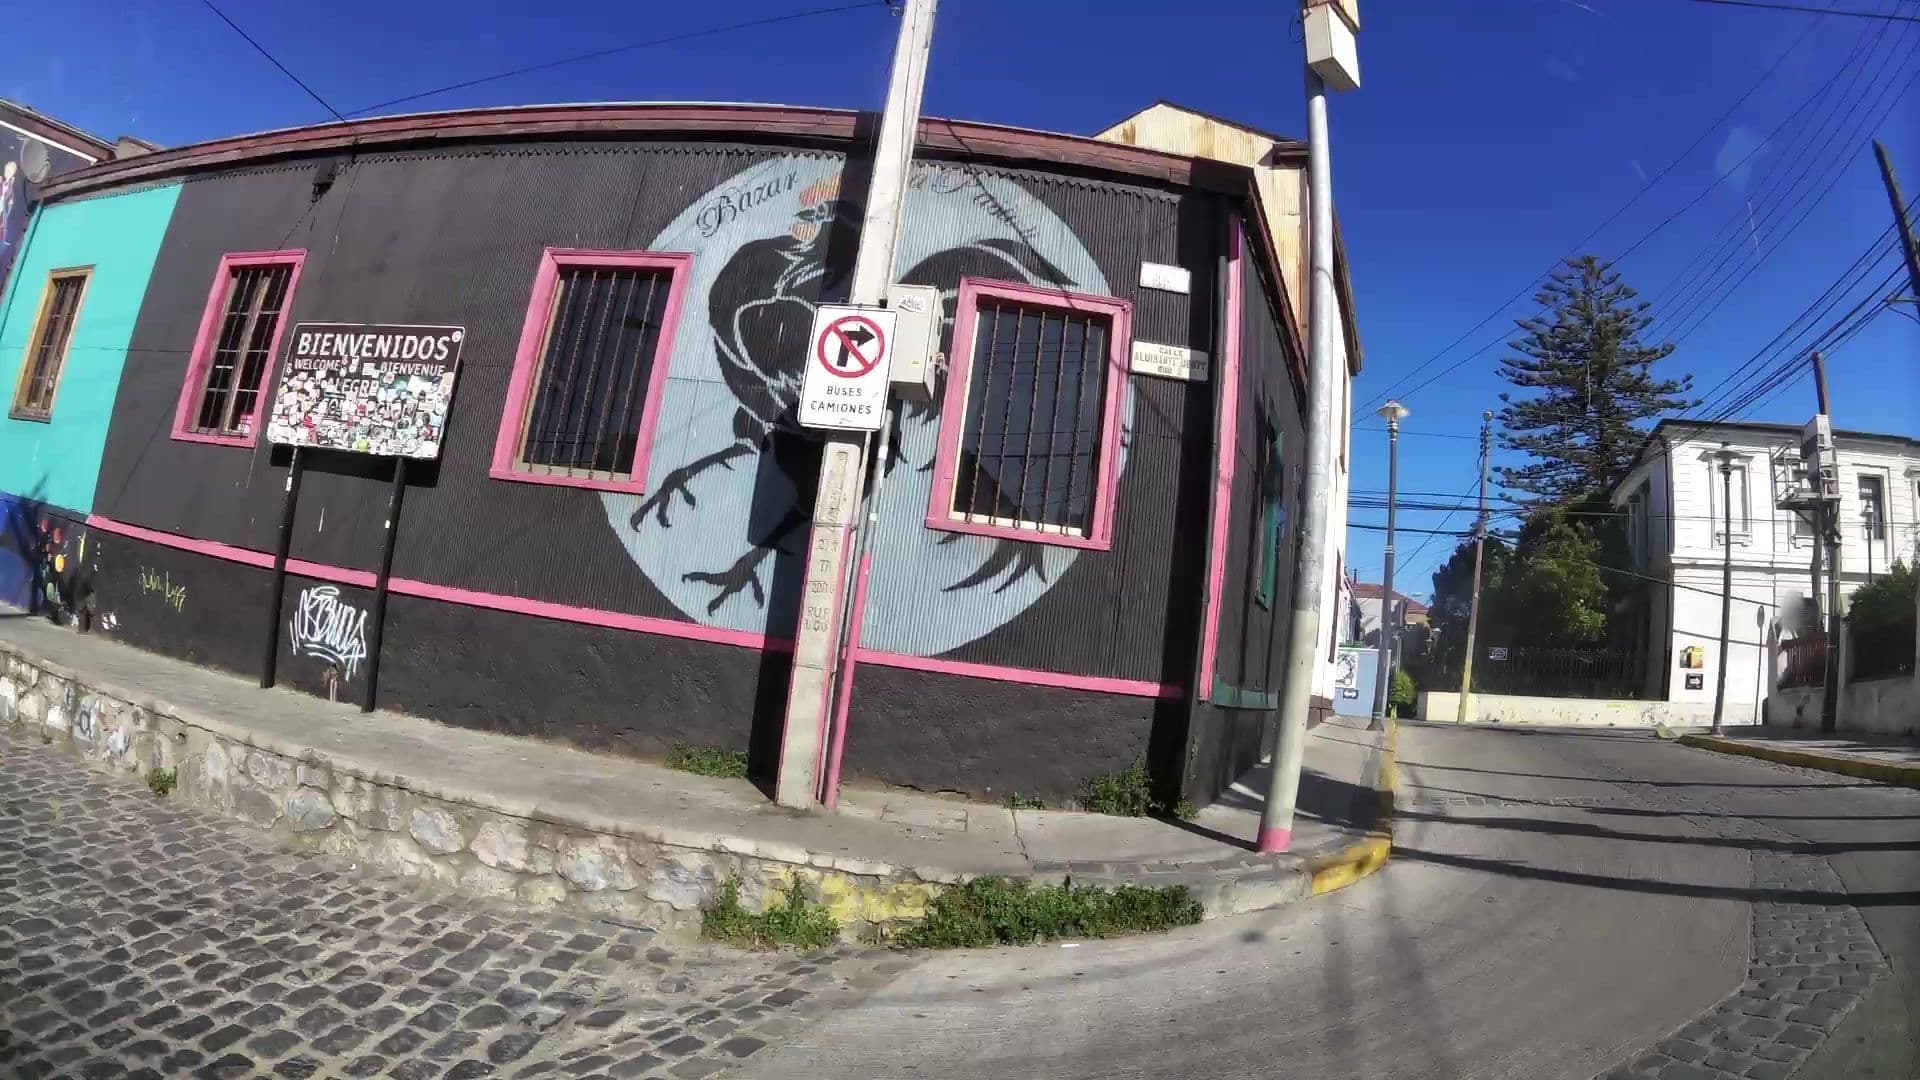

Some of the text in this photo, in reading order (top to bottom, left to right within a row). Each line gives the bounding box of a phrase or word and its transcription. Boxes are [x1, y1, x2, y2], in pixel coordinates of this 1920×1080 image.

[696, 170, 799, 238] Bazar
[297, 333, 450, 361] BIENVENIDOS
[294, 358, 341, 371] WELCOME
[380, 361, 446, 377] BIENVENUE
[826, 385, 862, 397] BUSES
[810, 400, 872, 415] CAMIONES
